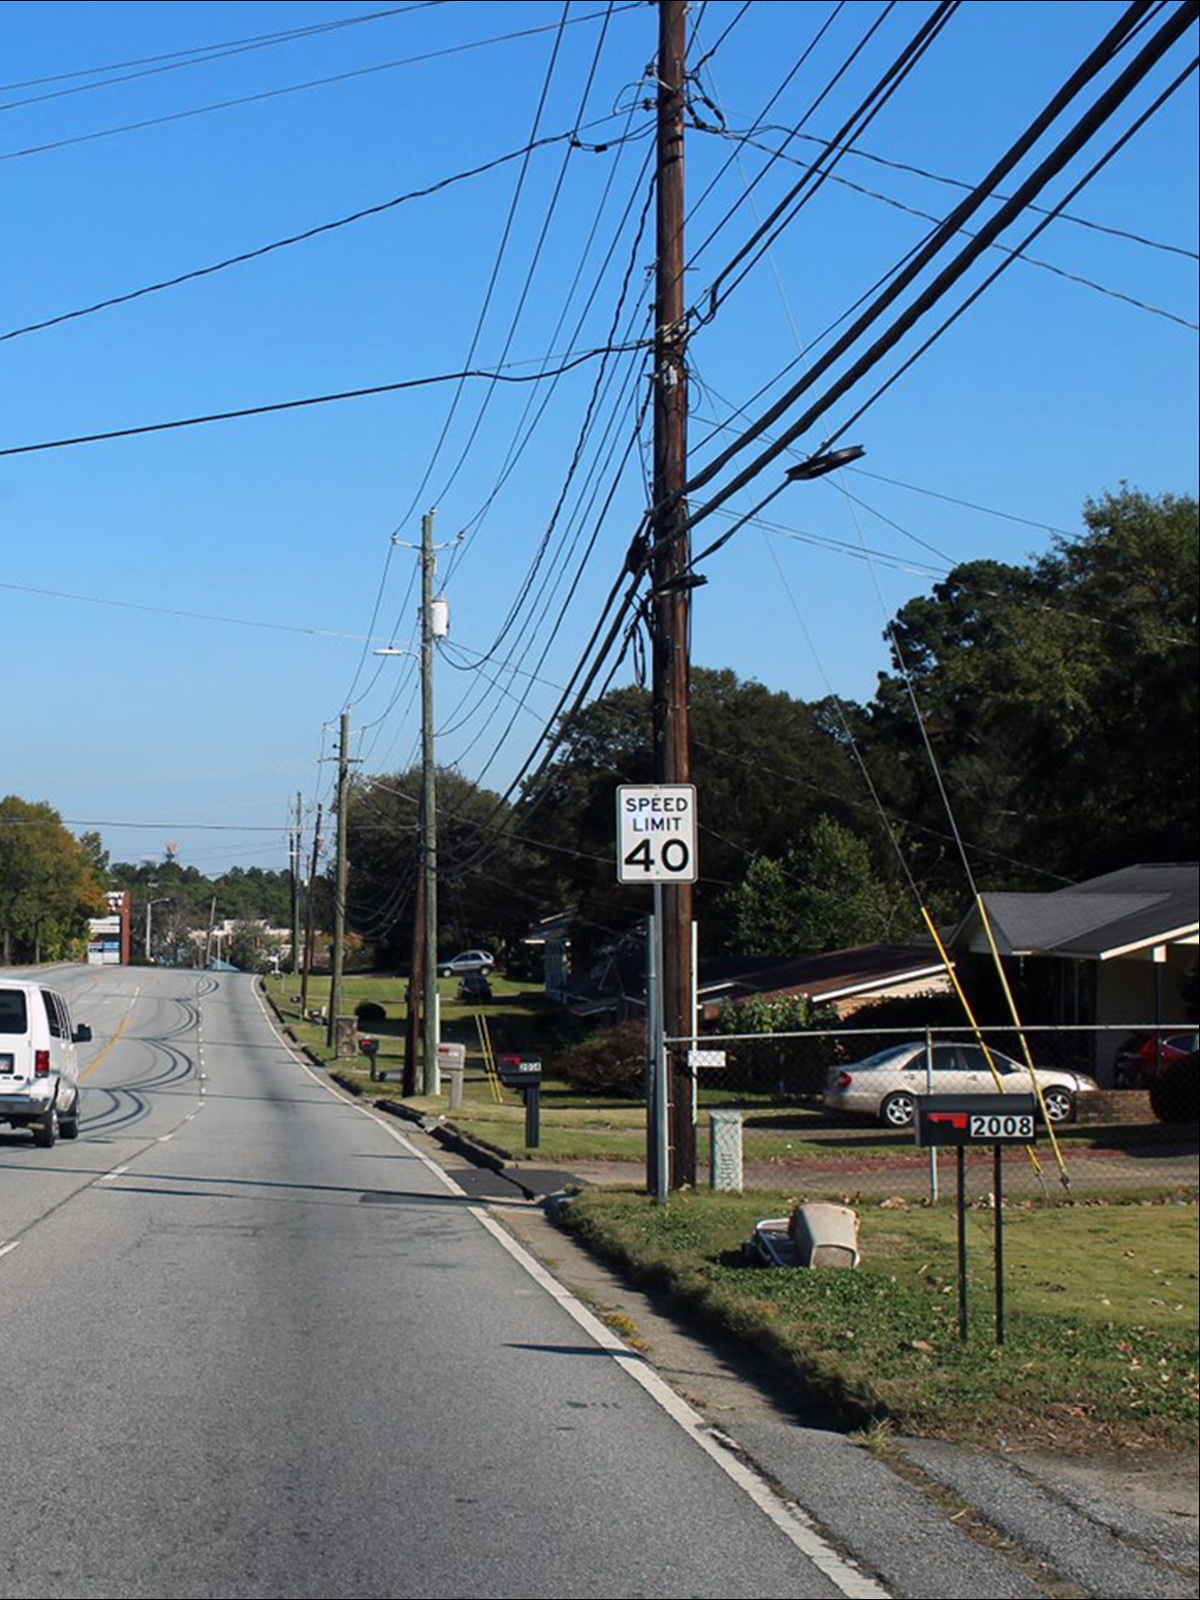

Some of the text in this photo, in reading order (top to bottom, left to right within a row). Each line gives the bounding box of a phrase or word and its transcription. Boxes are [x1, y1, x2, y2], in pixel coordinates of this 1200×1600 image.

[625, 797, 689, 813] SPEED
[633, 817, 682, 832] LIMIT
[624, 838, 689, 872] 40
[972, 1116, 1032, 1136] 2008
